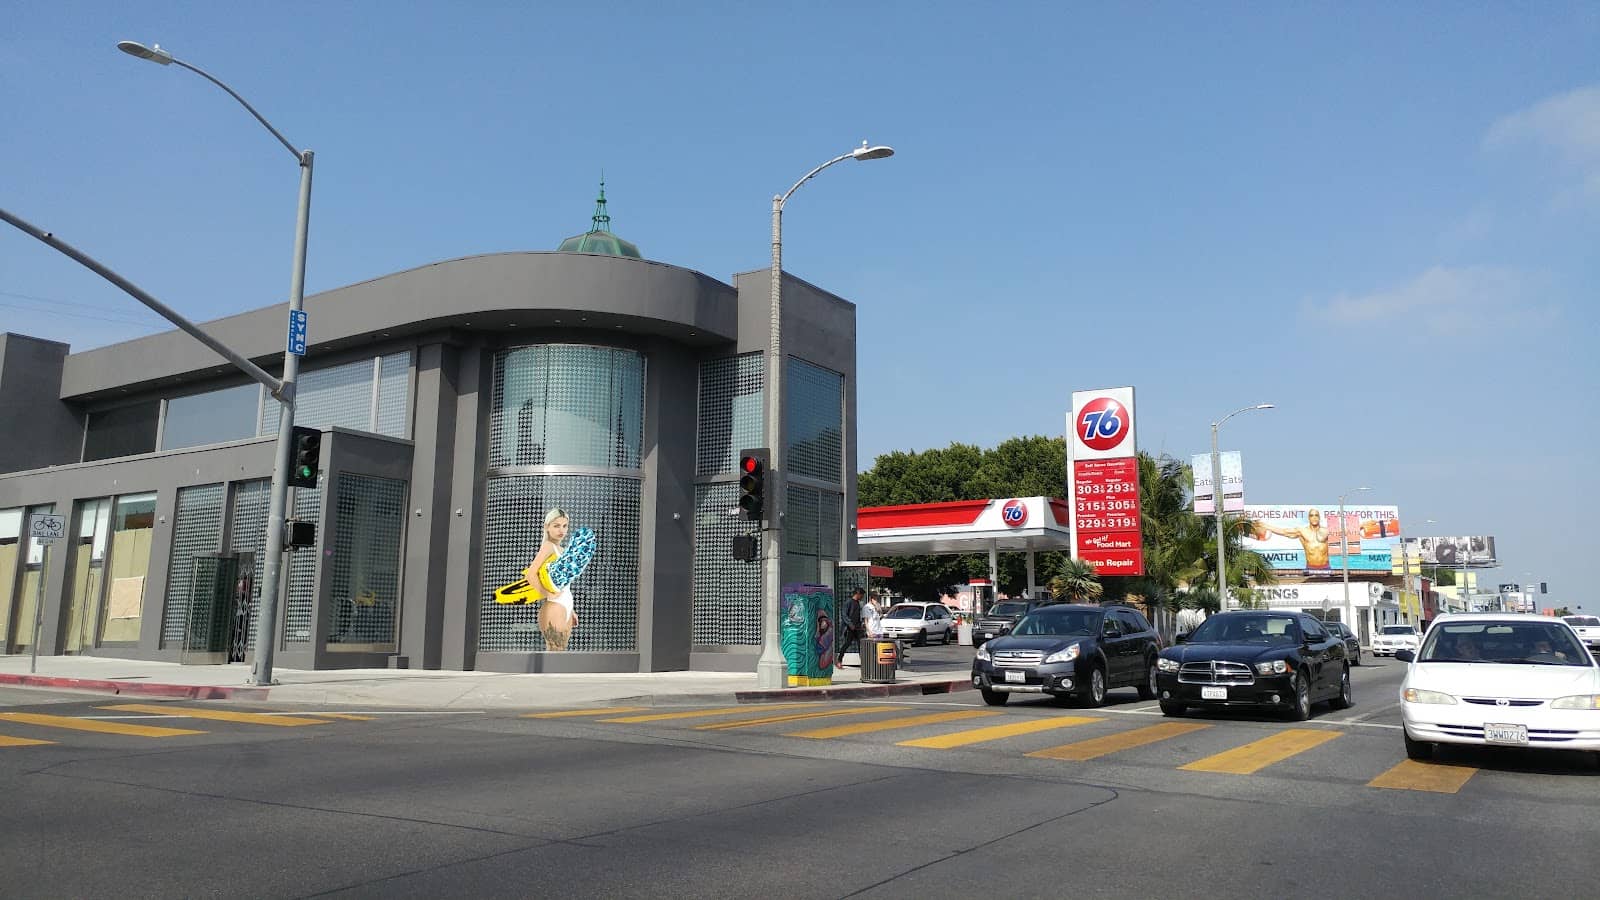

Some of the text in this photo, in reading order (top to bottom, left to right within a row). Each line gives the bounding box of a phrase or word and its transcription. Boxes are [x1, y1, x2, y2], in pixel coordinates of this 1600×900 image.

[296, 313, 306, 352] SYNC
[1082, 406, 1122, 440] 76
[1004, 504, 1023, 520] 76
[1282, 510, 1305, 519] AIN'T
[1354, 510, 1373, 519] FOR
[1260, 553, 1298, 561] WATCH
[1106, 559, 1135, 568] Repair
